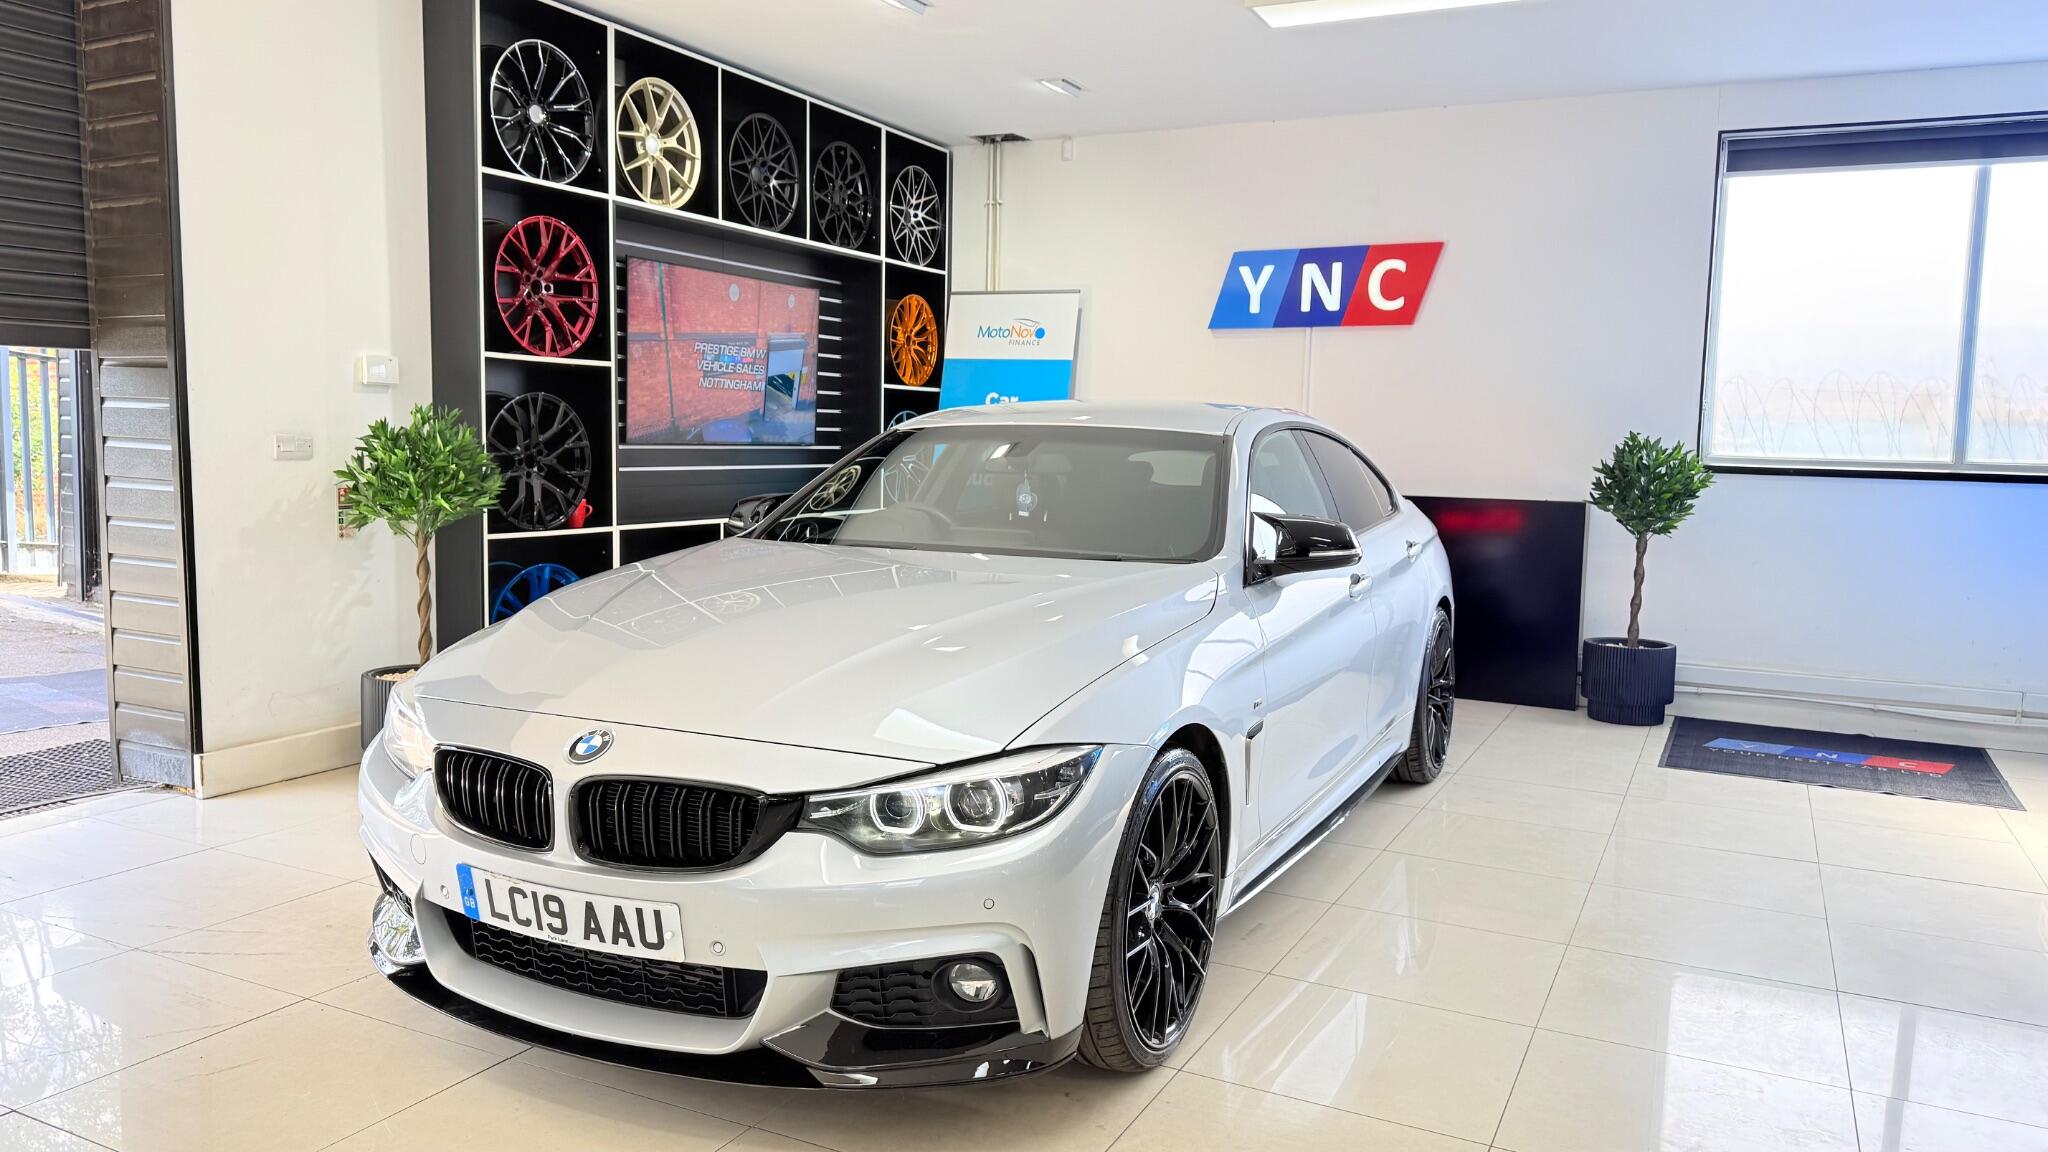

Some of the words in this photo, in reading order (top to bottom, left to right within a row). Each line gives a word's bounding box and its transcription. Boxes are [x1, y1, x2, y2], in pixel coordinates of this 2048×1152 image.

[1238, 258, 1407, 314] YNC
[694, 342, 740, 356] PRESTIGE
[740, 347, 767, 359] BMW
[697, 360, 735, 373] VEHICLE
[736, 363, 765, 374] SALES
[699, 377, 761, 392] NOTTINGHAM
[985, 391, 1020, 405] Car
[1709, 747, 1766, 758] YOUR
[1777, 754, 1832, 766] NEXT
[1845, 763, 1888, 772] CAR
[1901, 769, 1942, 778] LTD
[464, 896, 476, 909] GB
[485, 879, 568, 936] LC19
[583, 901, 666, 951] AAU
